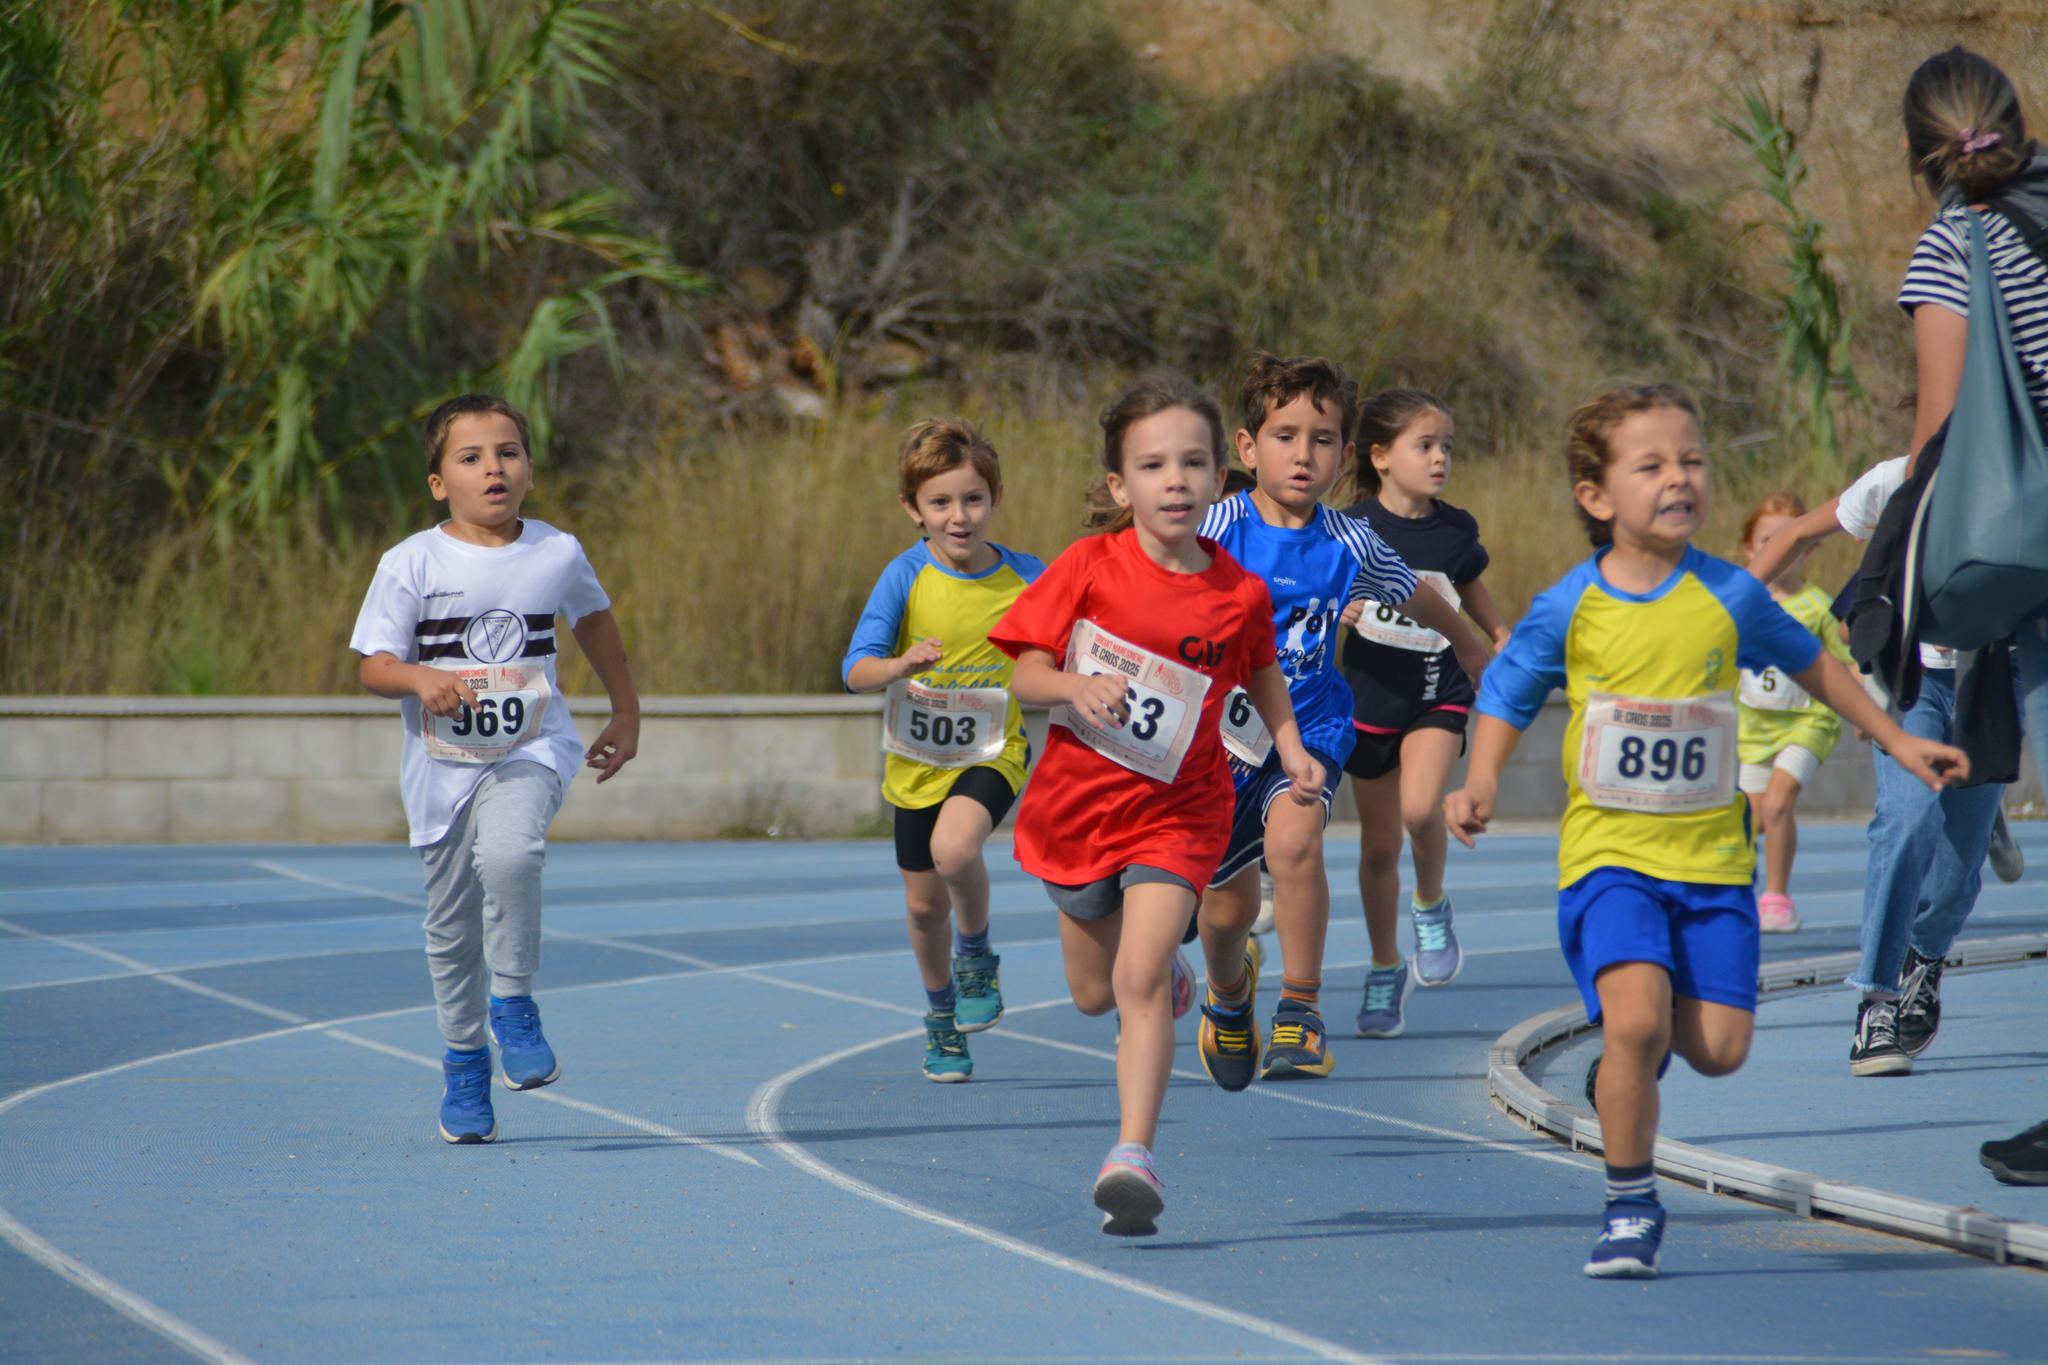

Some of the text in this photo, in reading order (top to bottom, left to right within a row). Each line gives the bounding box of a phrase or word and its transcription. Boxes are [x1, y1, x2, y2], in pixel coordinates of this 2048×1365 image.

[1091, 642, 1101, 657] DE
[1099, 648, 1119, 667] CROS
[1118, 658, 1141, 677] 2025
[470, 678, 488, 689] 2025
[1762, 670, 1776, 693] 5
[451, 697, 524, 737] 969
[910, 710, 976, 746] 503
[1618, 736, 1707, 782] 896
